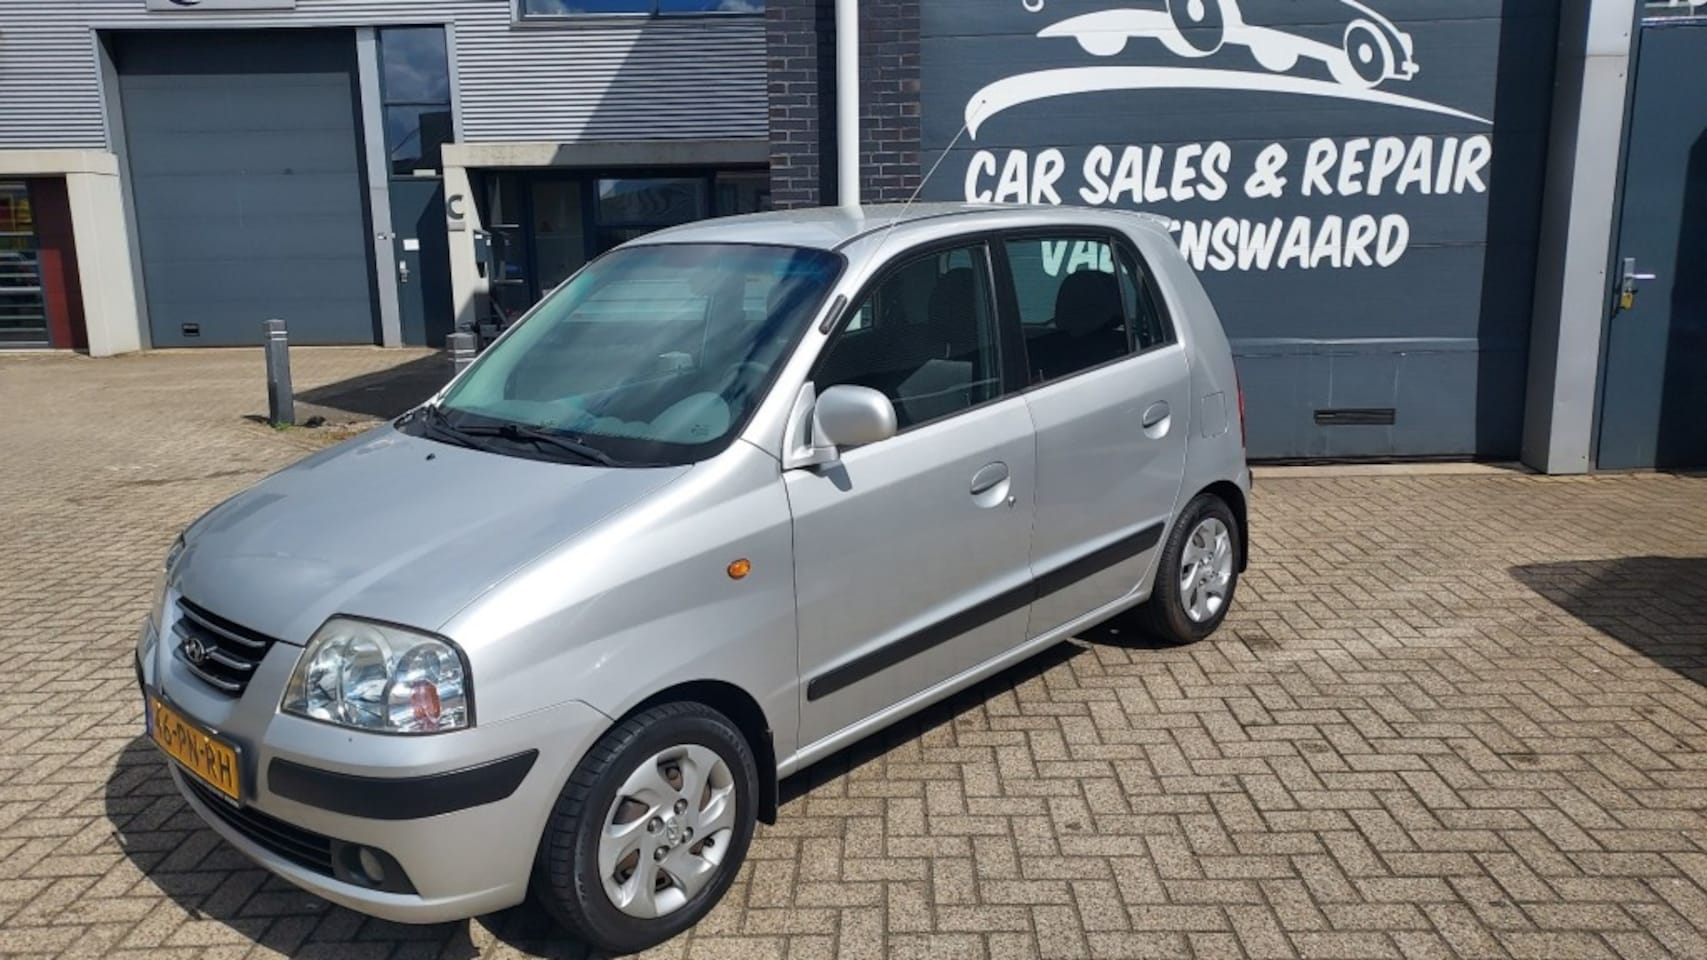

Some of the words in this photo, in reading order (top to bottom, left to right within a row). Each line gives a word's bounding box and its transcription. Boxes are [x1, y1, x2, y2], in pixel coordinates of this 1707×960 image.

[964, 149, 1065, 206] CAR
[1079, 141, 1231, 205] SALES
[1244, 143, 1288, 198] &
[1301, 135, 1492, 196] REPAIR
[447, 194, 464, 220] C
